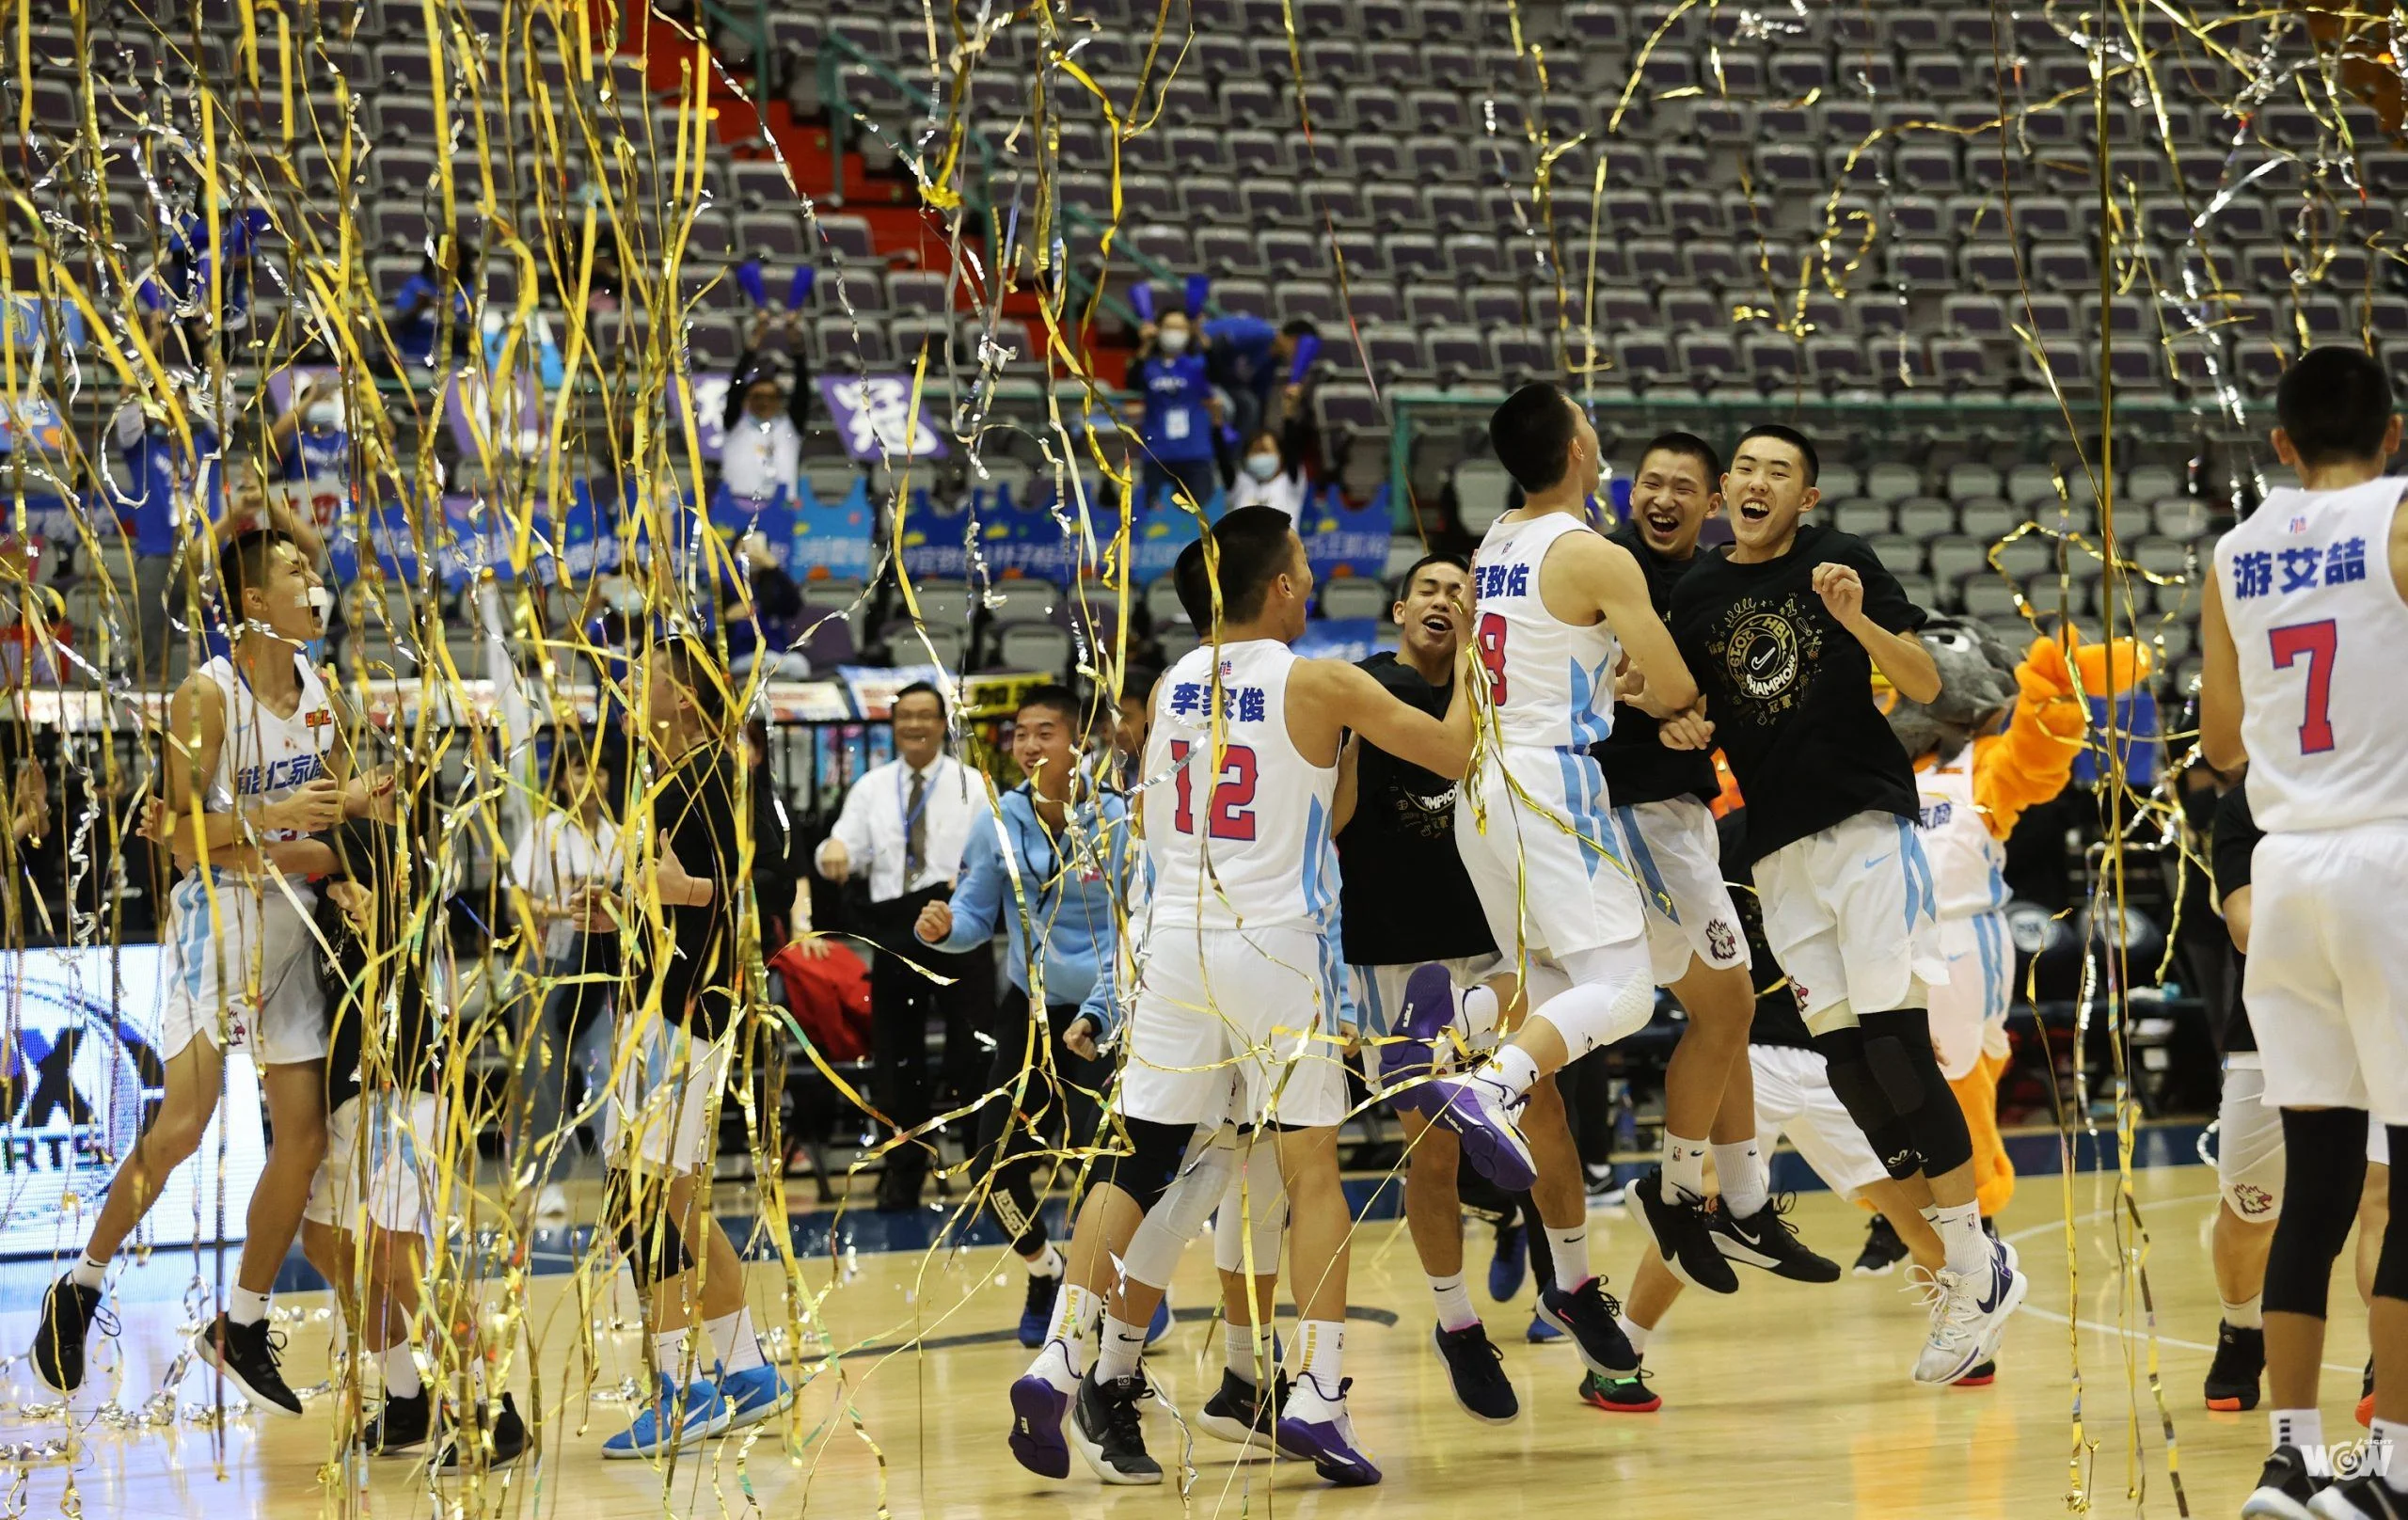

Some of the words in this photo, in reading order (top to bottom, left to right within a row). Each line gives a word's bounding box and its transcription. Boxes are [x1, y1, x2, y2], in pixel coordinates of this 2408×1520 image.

[1761, 616, 1792, 650] HBL
[1746, 654, 1797, 696] CHAMPIONS
[2268, 618, 2337, 755] 7
[1170, 681, 1266, 722] 李家俊
[1170, 738, 1259, 841] 12
